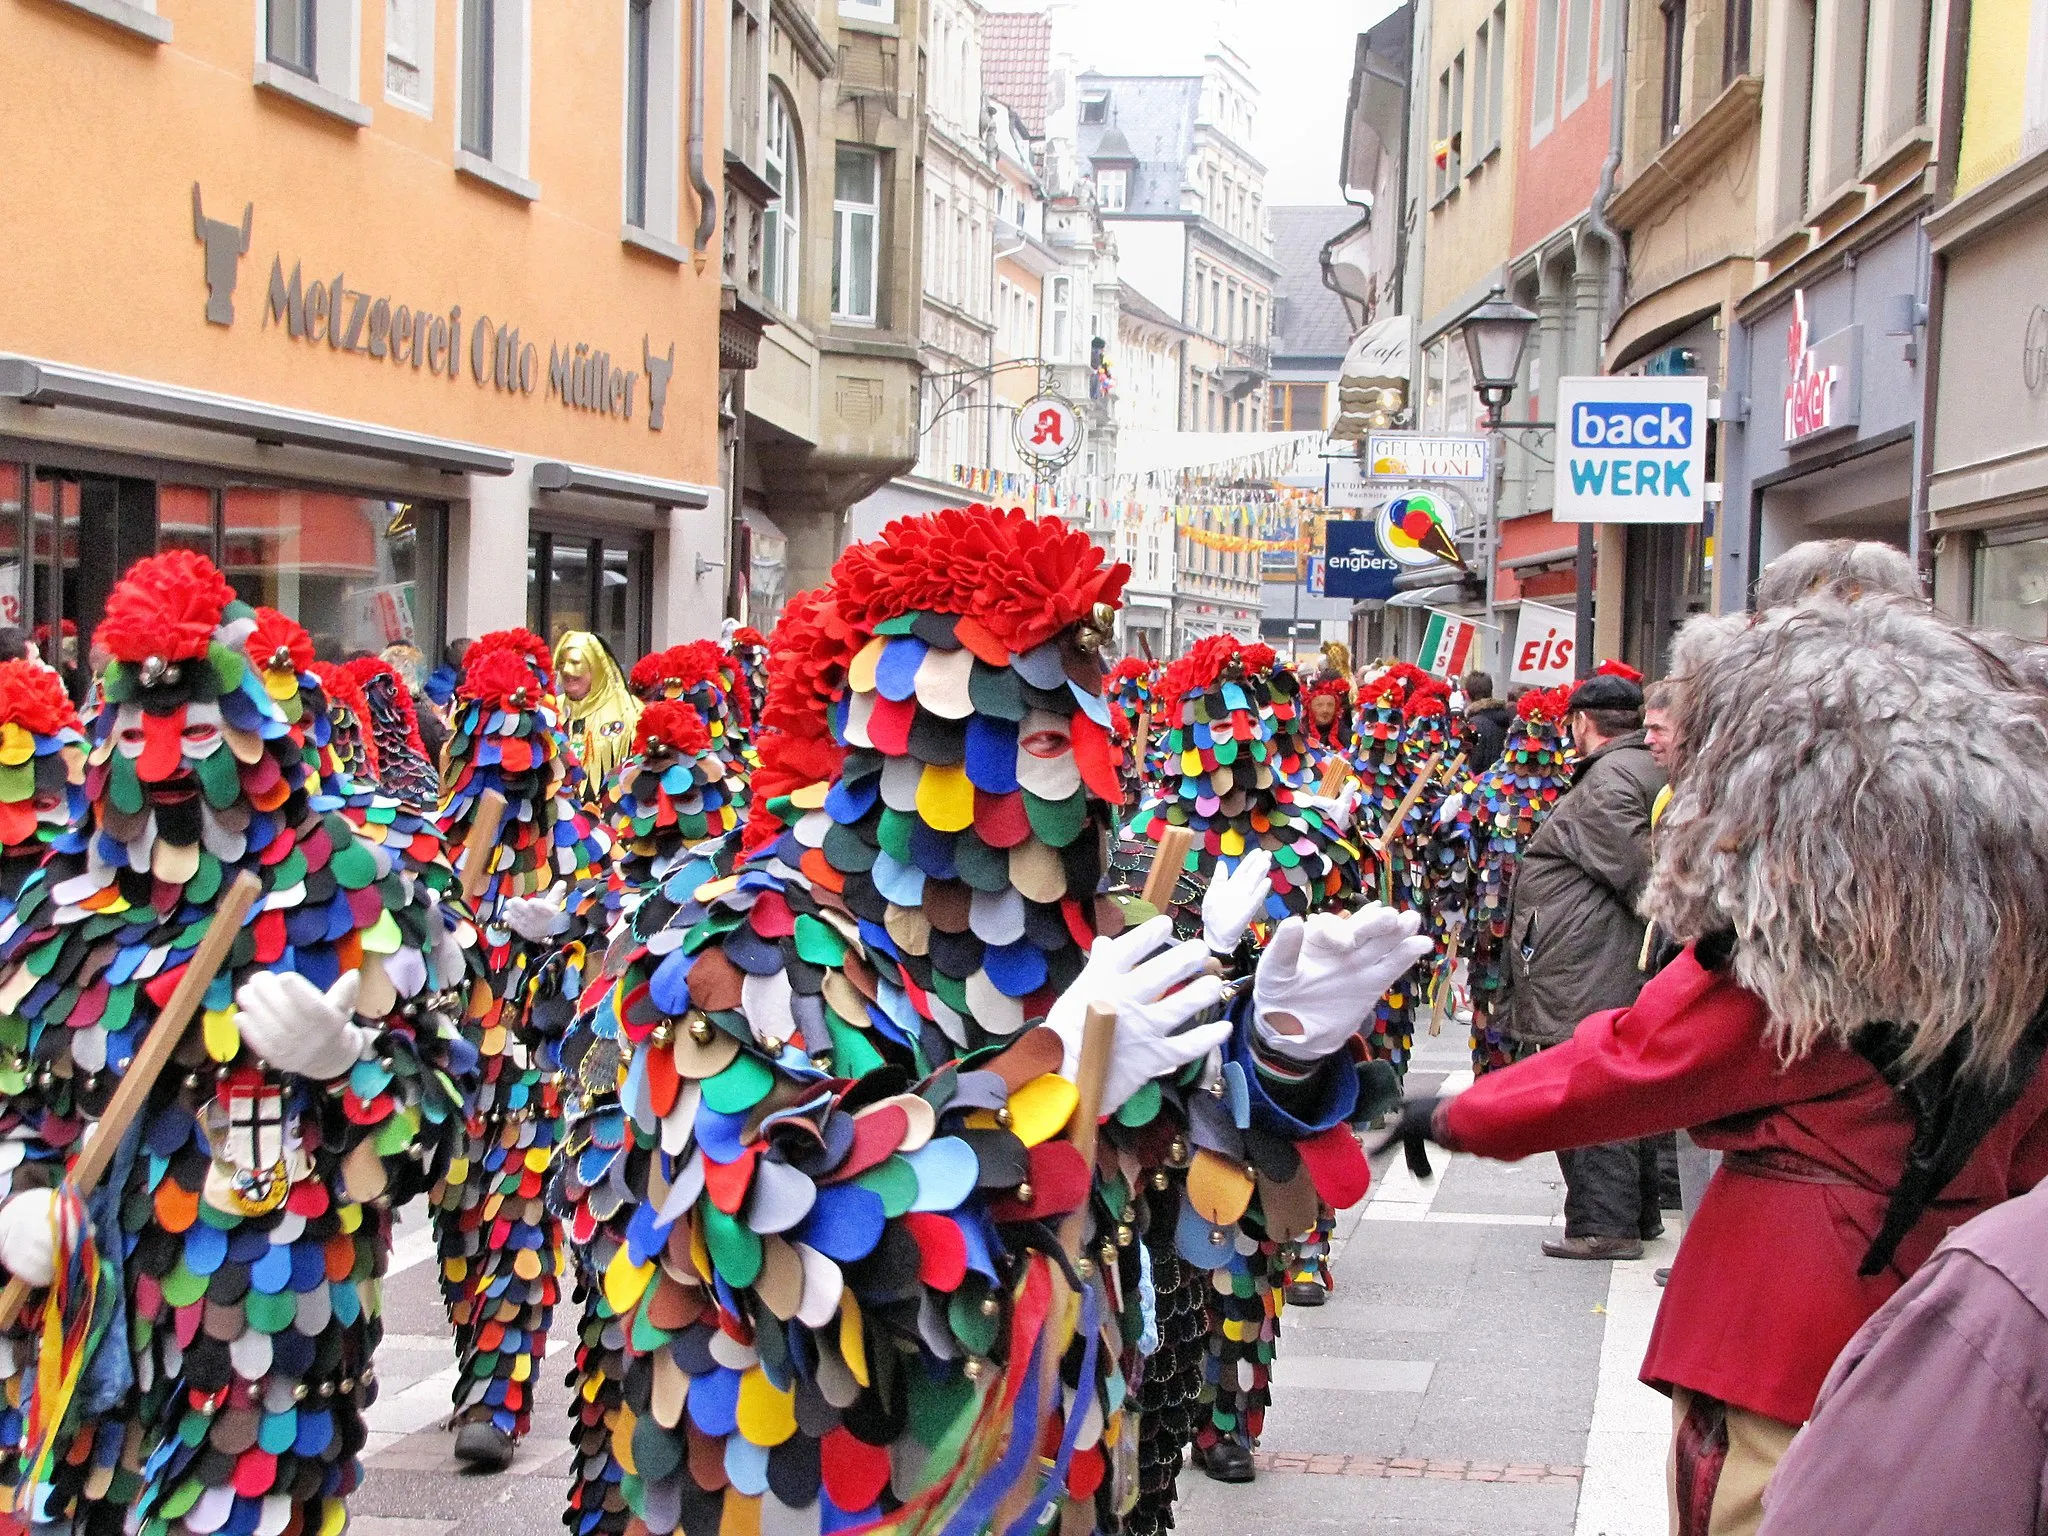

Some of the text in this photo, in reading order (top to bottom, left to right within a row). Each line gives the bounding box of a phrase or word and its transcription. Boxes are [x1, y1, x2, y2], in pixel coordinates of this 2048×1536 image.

[261, 251, 639, 418] Metzgerei Otto Müller
[1578, 406, 1686, 445] back
[1376, 440, 1481, 458] GELATERIA
[1421, 459, 1469, 476] TONI
[1570, 459, 1691, 497] WERK
[1329, 554, 1398, 573] engbers
[1436, 625, 1455, 667] EIS
